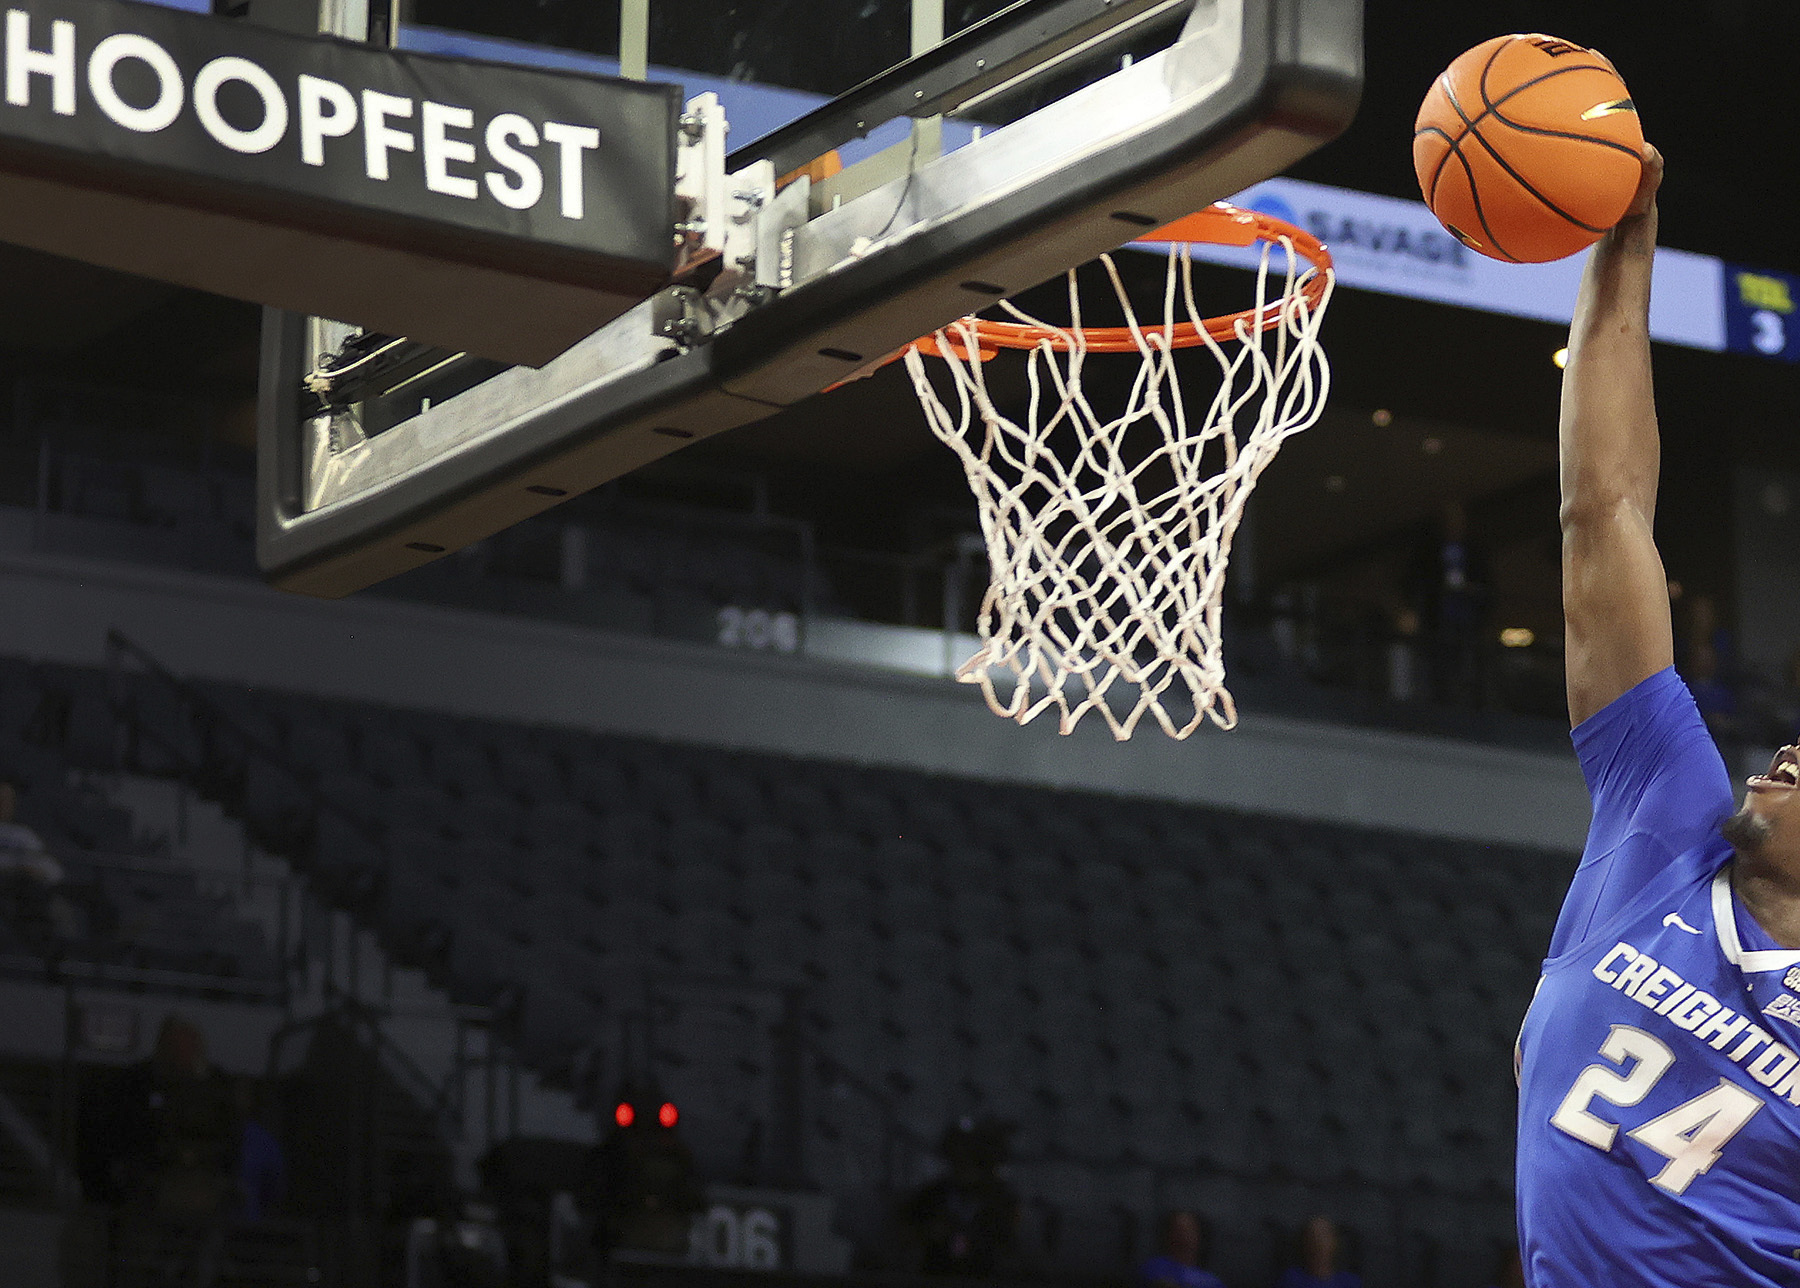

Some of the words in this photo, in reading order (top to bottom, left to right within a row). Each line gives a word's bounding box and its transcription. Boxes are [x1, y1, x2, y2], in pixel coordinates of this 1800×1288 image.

[5, 9, 600, 219] HOOPFEST
[1751, 309, 1786, 354] 3
[1548, 1022, 1766, 1196] 24
